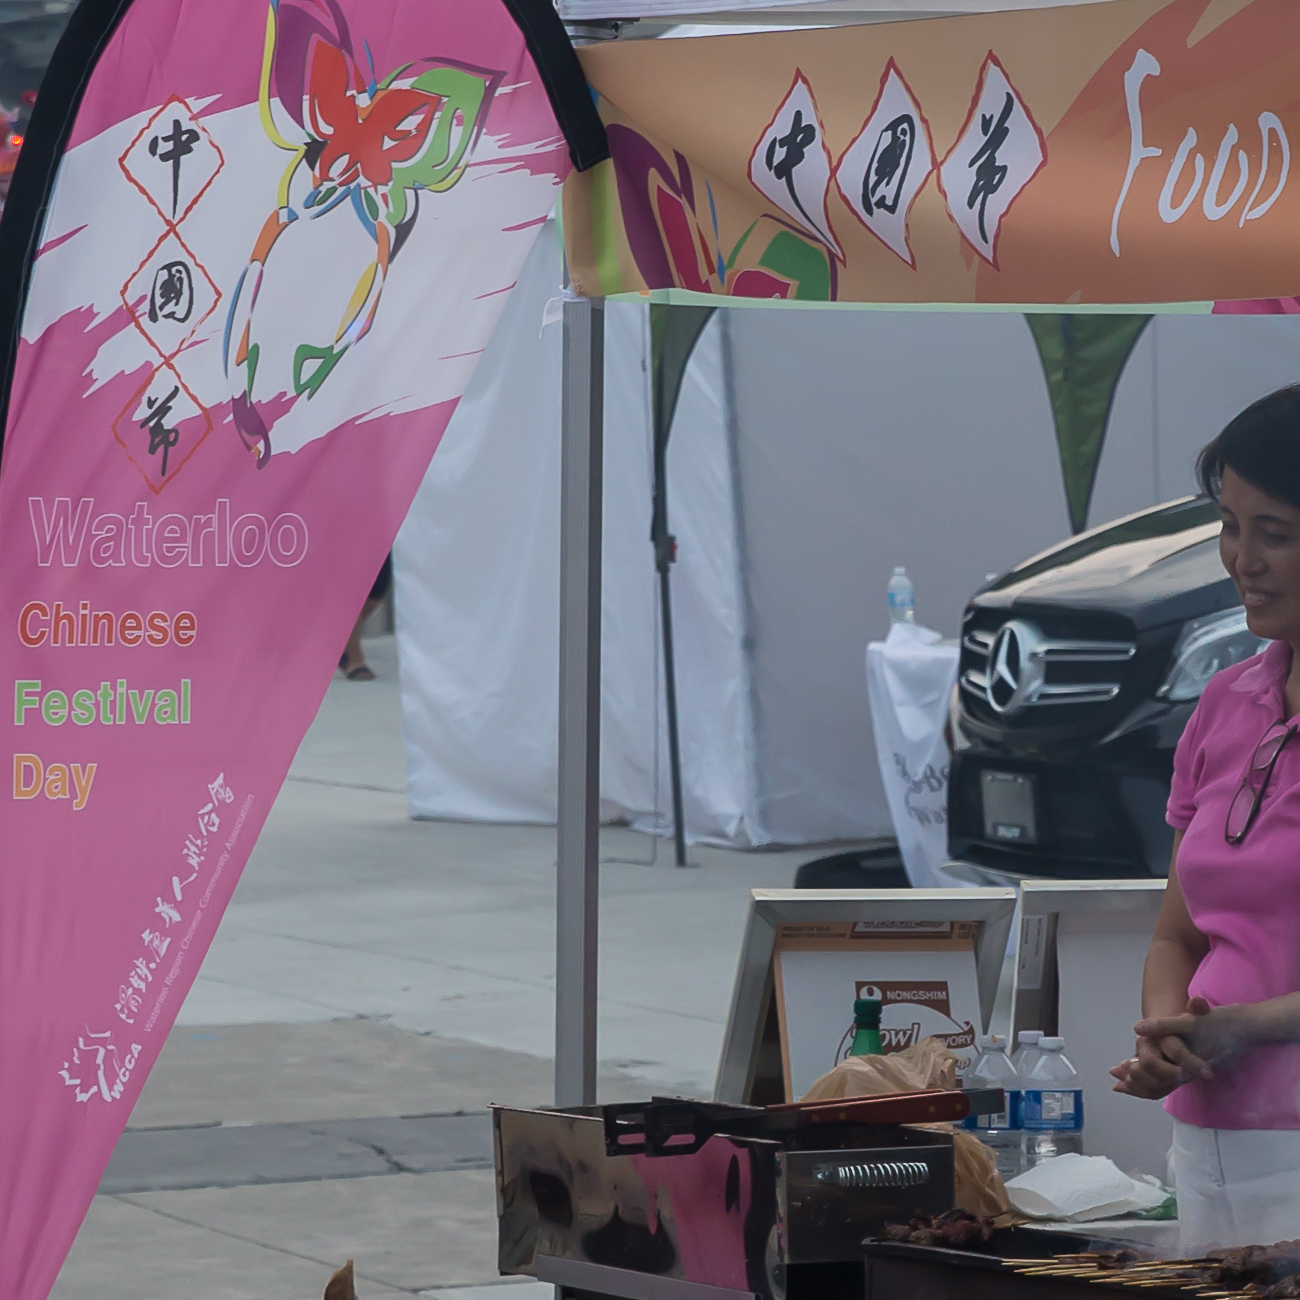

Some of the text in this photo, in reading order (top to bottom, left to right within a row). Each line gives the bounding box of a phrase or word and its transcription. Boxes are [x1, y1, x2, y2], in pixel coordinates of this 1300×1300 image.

[1107, 48, 1291, 258] FOOD
[28, 497, 309, 568] Waterloo
[18, 600, 197, 648] Chinese
[13, 679, 192, 726] Festival
[13, 753, 97, 810] Day
[180, 909, 203, 951] Chinese
[199, 850, 230, 909] Community
[225, 793, 255, 850] Association
[886, 990, 947, 1000] NONGSHIM
[110, 1043, 142, 1100] WCCA
